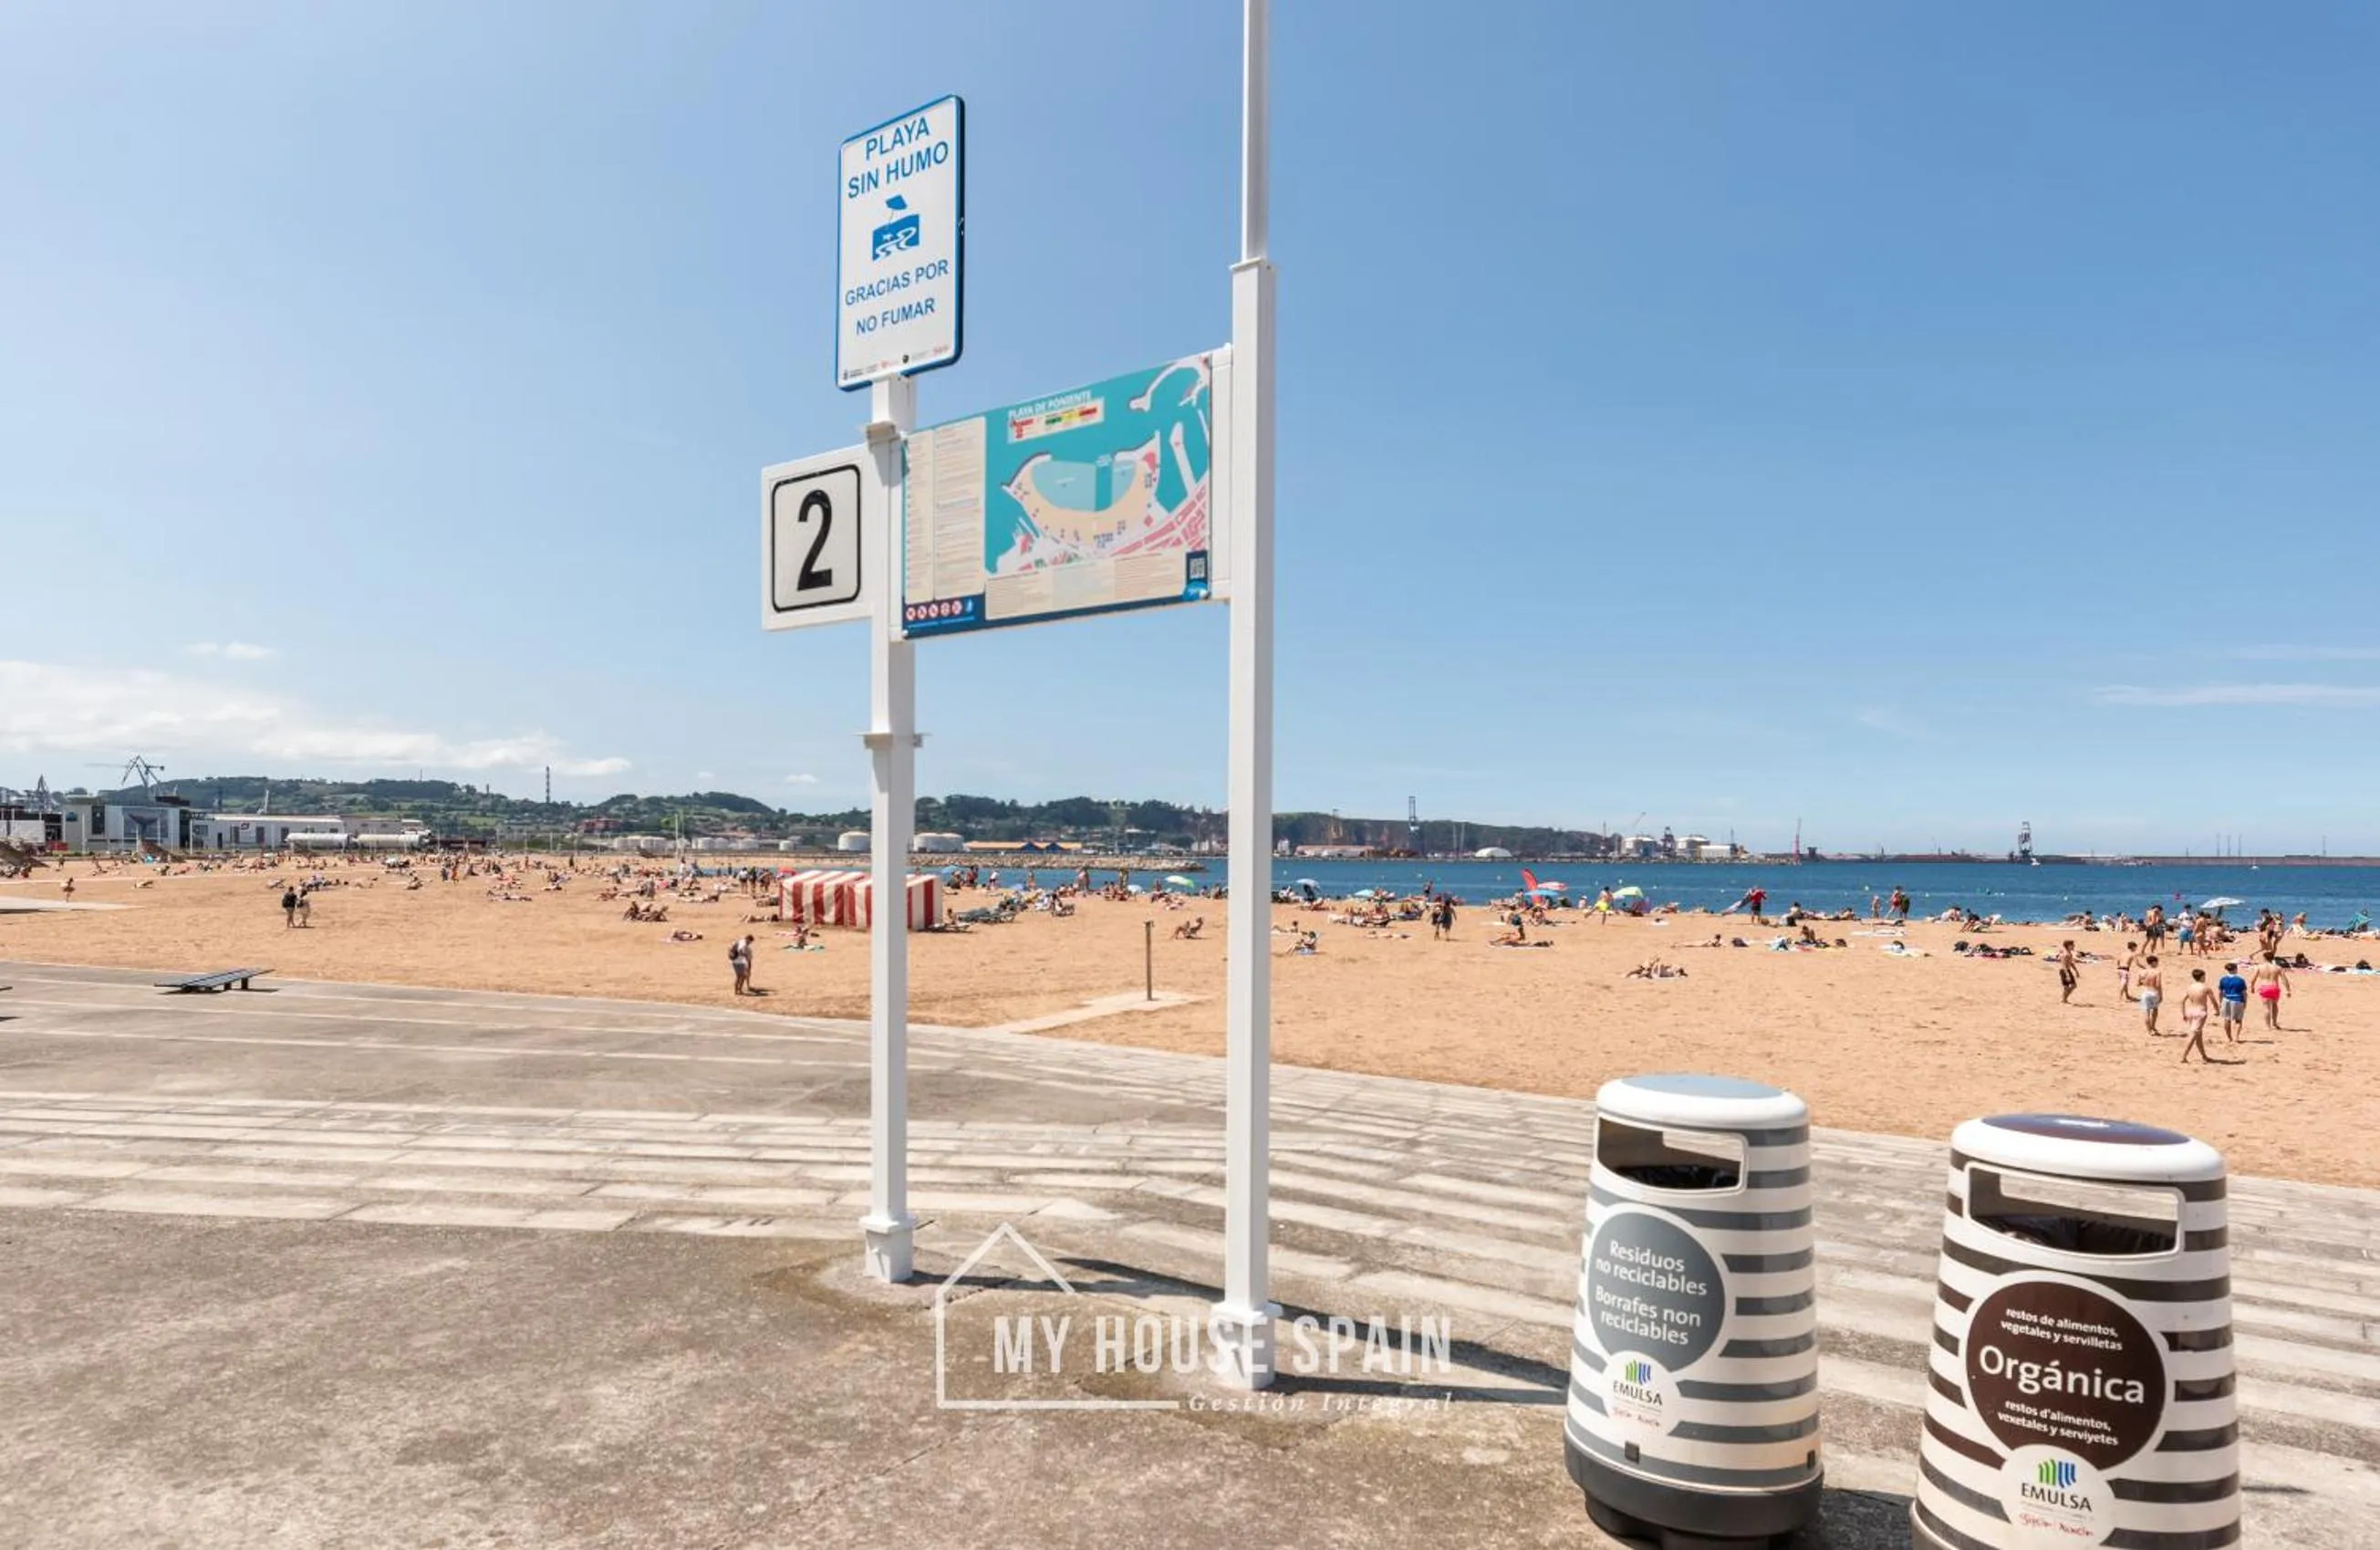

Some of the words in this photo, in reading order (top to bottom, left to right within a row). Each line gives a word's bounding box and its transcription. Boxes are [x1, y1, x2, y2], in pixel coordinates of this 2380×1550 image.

[866, 117, 930, 161] PLAYA
[848, 168, 878, 199] SIN
[887, 141, 949, 183] HUMO
[845, 272, 909, 306] GRACIAS
[916, 259, 949, 281] POR
[857, 315, 877, 336] NO
[882, 297, 935, 327] FUMAR
[797, 489, 833, 591] 2
[1610, 1240, 1686, 1272] Residuos
[1595, 1258, 1611, 1274] no
[1613, 1264, 1708, 1295] reciclables
[1595, 1285, 1658, 1319] Borrafes
[1663, 1307, 1700, 1327] non
[2006, 1307, 2038, 1323] restos
[2040, 1315, 2054, 1326] de
[2056, 1317, 2119, 1337] alimentos,
[1600, 1310, 1689, 1346] reciclables
[2001, 1320, 2052, 1340] vegetales
[2053, 1332, 2062, 1343] y
[2063, 1332, 2124, 1351] servilletas
[1613, 1379, 1663, 1405] EMULSA
[1980, 1345, 2145, 1404] Orgánica
[2005, 1400, 2038, 1416] restos
[1998, 1412, 2049, 1432] vexetales
[2050, 1425, 2058, 1437] y
[2060, 1427, 2119, 1445] serviyetes
[2021, 1482, 2093, 1512] EMULSA
